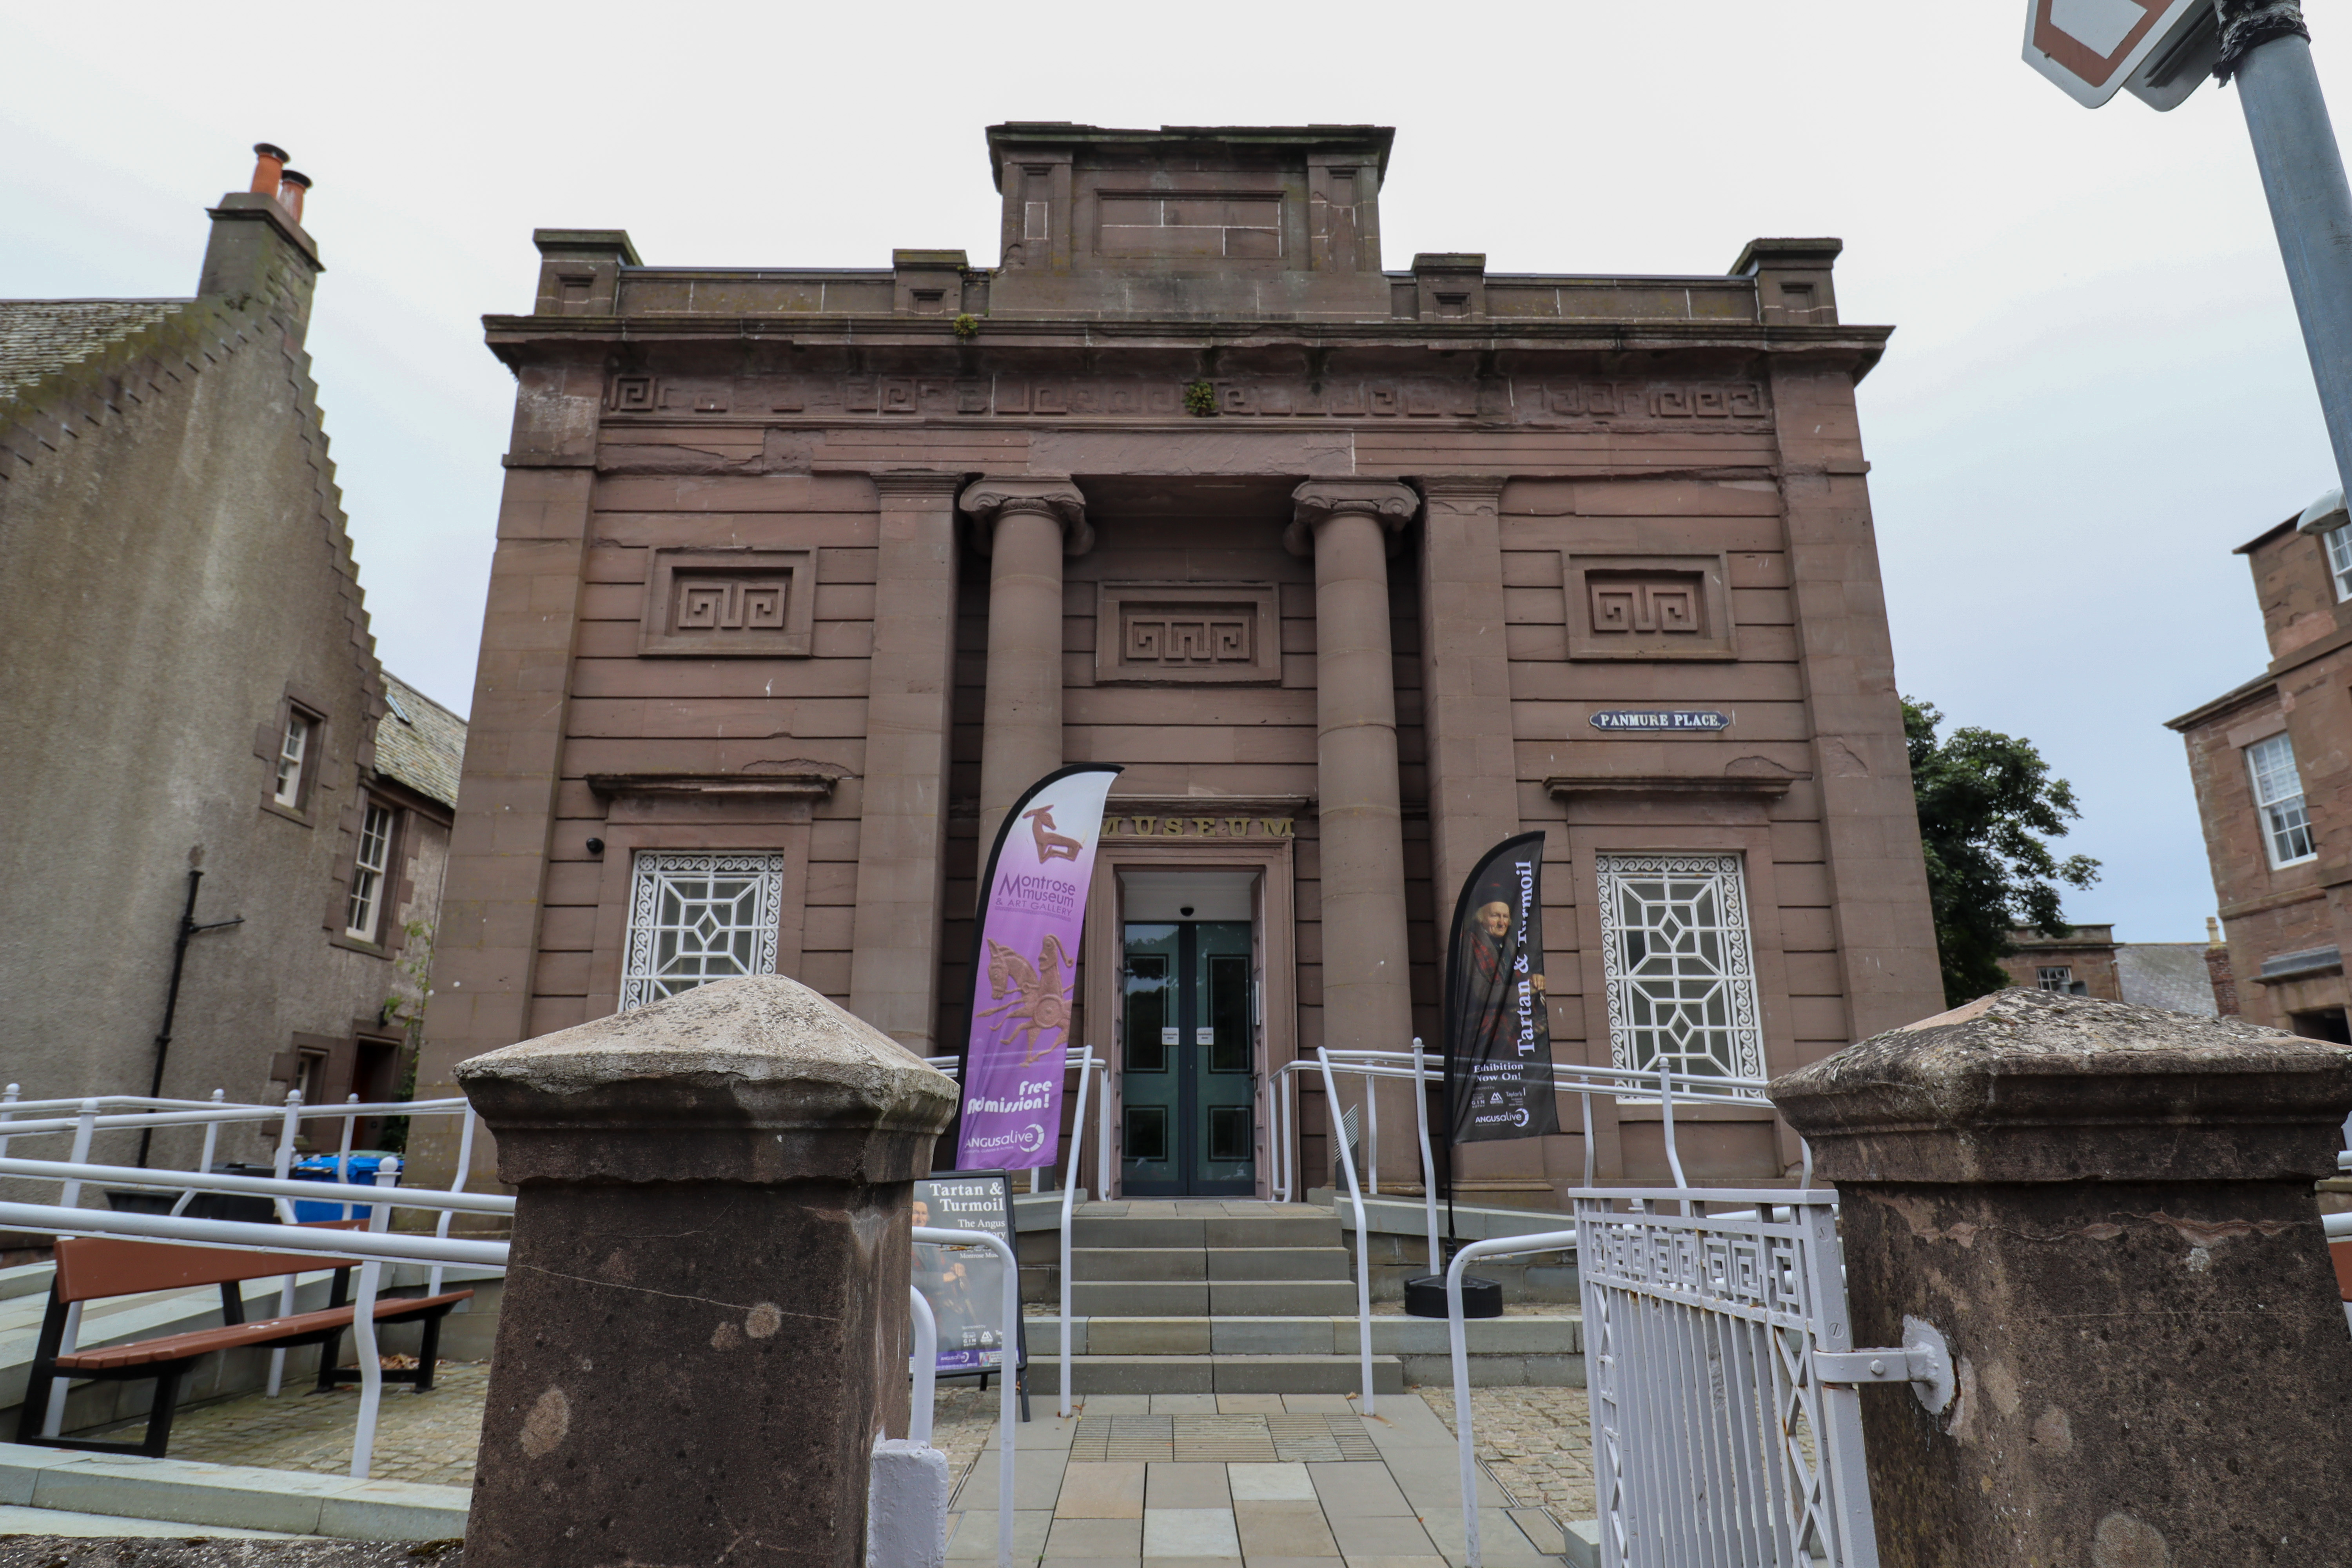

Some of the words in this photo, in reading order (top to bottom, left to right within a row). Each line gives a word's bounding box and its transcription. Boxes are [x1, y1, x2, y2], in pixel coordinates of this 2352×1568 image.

[1600, 714, 1668, 726] PANMURE
[1674, 715, 1720, 726] PLACE.
[1100, 816, 1294, 836] MUSEUM
[998, 873, 1075, 897] Montrose
[1023, 889, 1073, 907] museum
[1031, 902, 1072, 916] GALLERY
[1514, 954, 1529, 973] &
[1517, 978, 1535, 1056] Tartan
[1019, 1081, 1052, 1095] Free
[967, 1093, 1049, 1114] Admission!
[1475, 1111, 1522, 1123] ANGUSalive
[965, 1130, 1033, 1148] ANGUSalive
[929, 1183, 984, 1196] Tartan
[989, 1181, 1003, 1195] &
[940, 1198, 1004, 1212] Turmoil
[958, 1219, 975, 1227] The
[978, 1219, 1005, 1229] Angus
[983, 1230, 1005, 1240] ory
